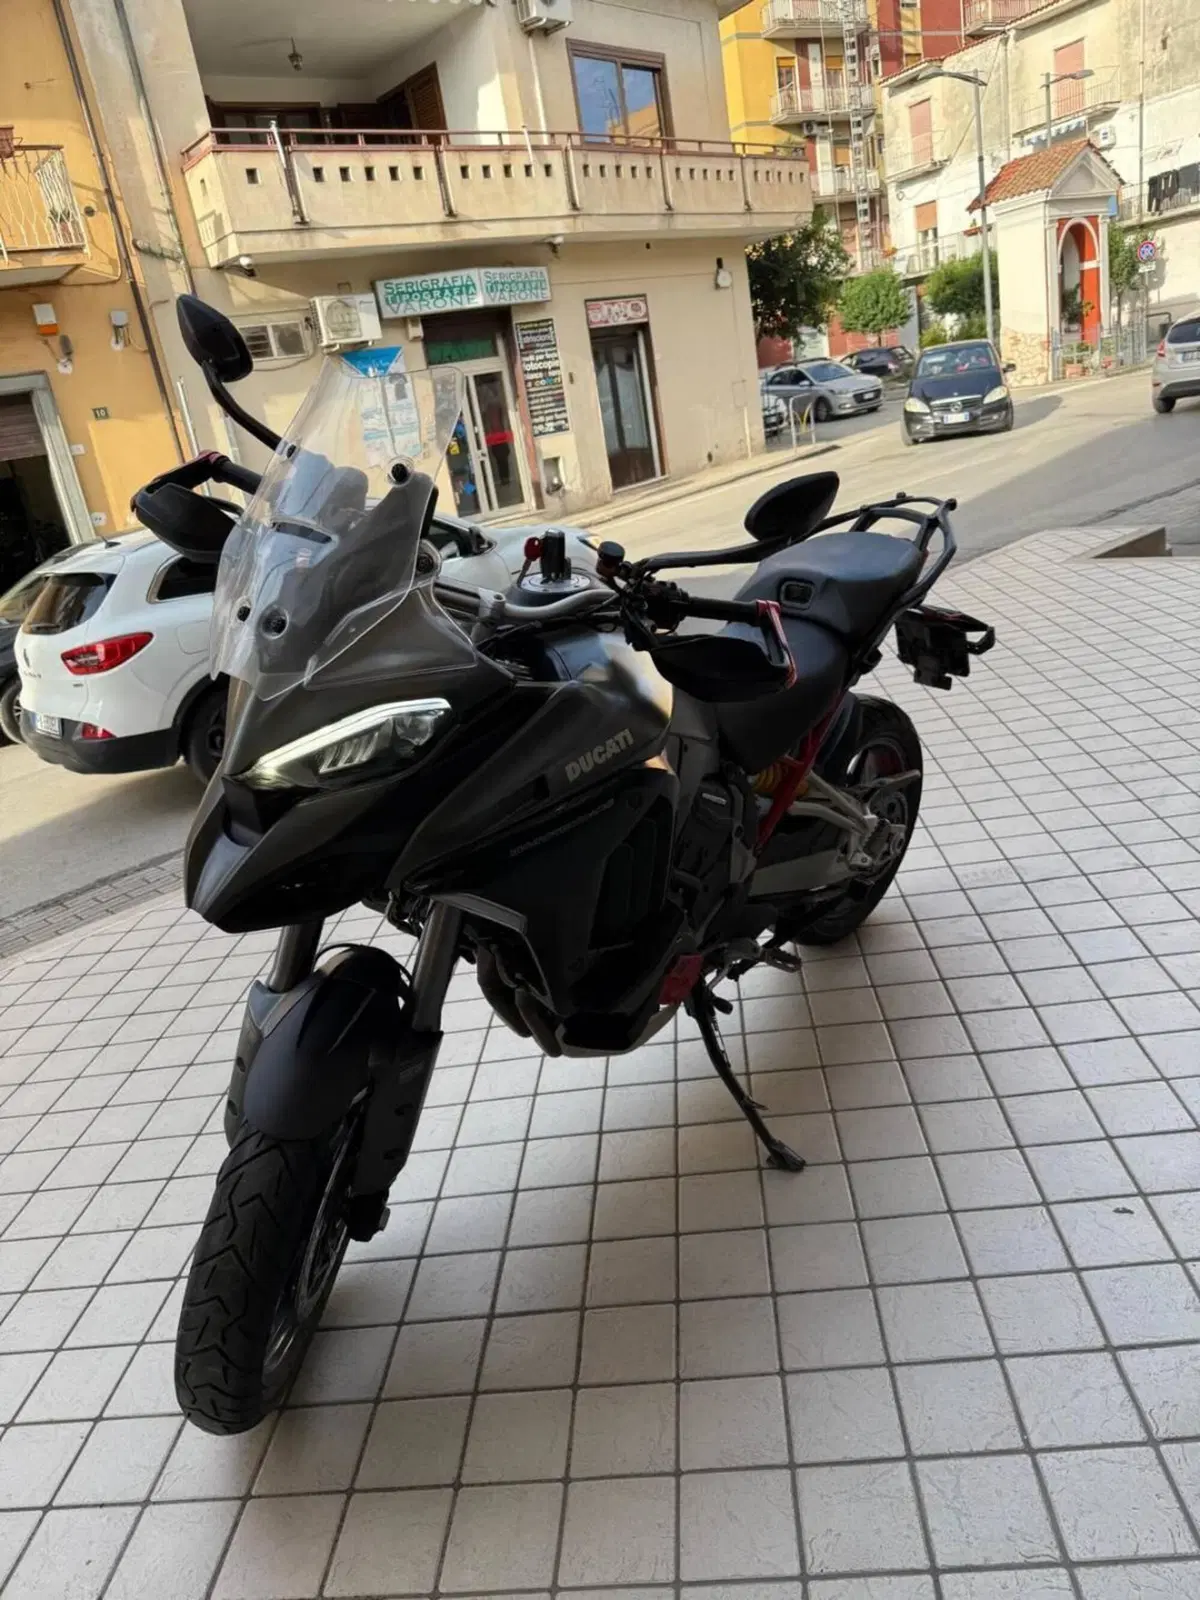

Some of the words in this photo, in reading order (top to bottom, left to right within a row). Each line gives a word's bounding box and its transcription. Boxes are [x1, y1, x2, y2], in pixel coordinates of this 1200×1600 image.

[384, 274, 475, 293] SERIGRAFIA
[484, 270, 546, 283] SERIGRAFIA
[385, 285, 477, 304] TIPOGRAFIA
[486, 281, 547, 292] TIPOGRAFIA
[486, 289, 549, 303] VARONE
[385, 295, 480, 315] VARONE
[95, 408, 106, 418] 10
[565, 728, 634, 782] DUCATI
